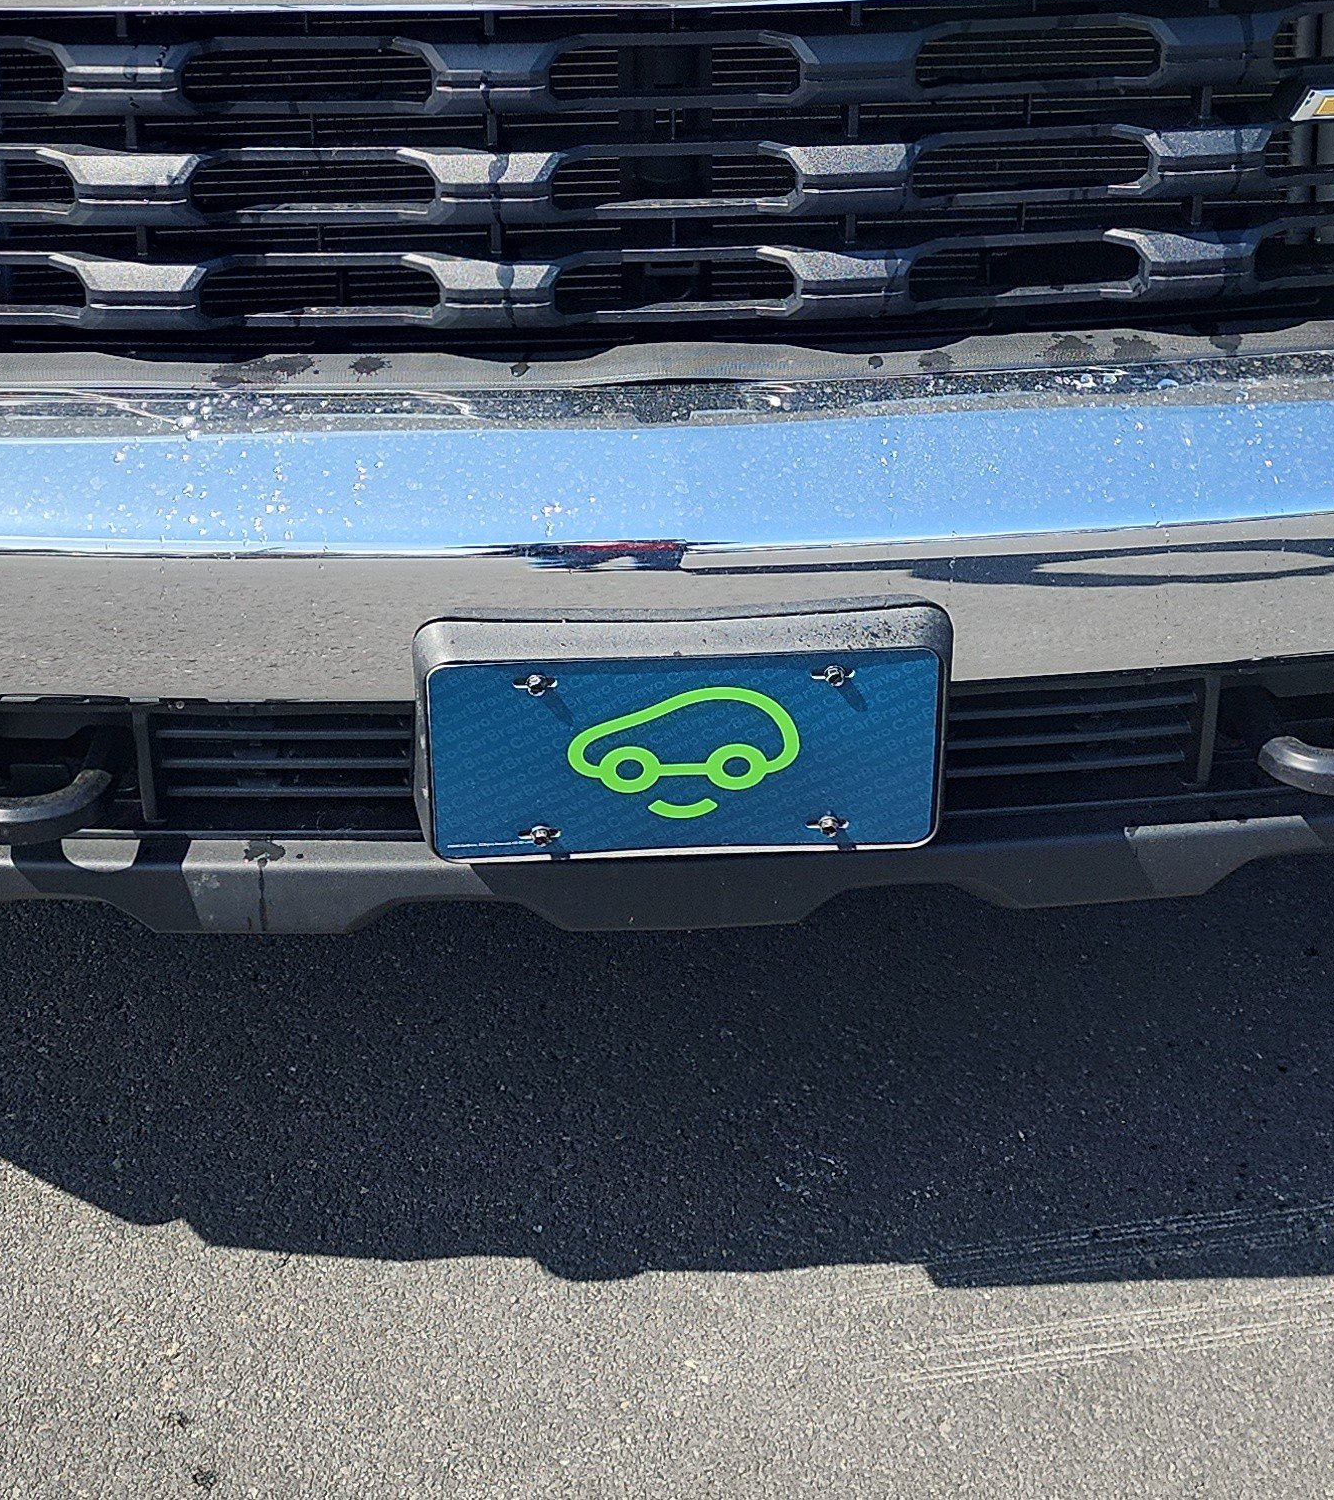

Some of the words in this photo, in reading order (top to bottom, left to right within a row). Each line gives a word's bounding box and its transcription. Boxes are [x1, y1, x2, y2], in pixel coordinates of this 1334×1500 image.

[587, 681, 665, 716] CarBravo
[458, 717, 532, 753] CarBravo
[840, 700, 916, 735] CarBravo
[476, 746, 552, 780] CarBravo
